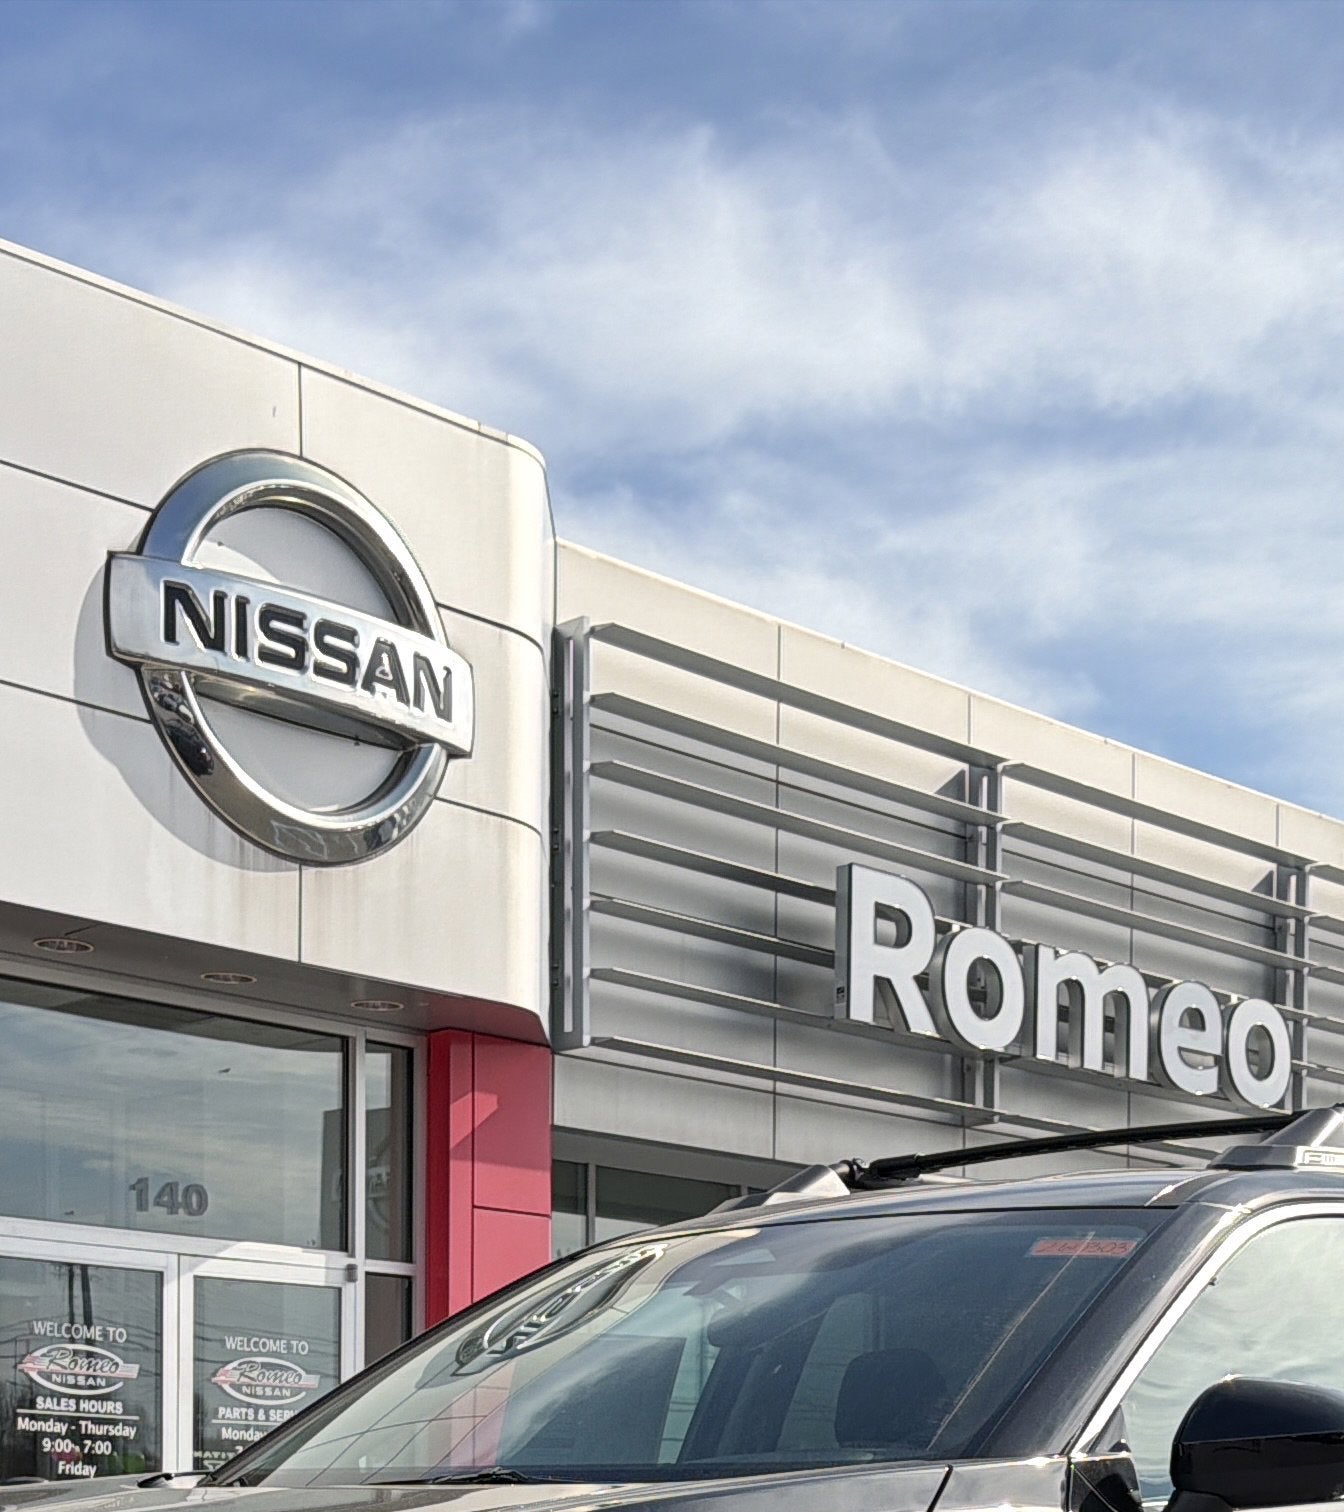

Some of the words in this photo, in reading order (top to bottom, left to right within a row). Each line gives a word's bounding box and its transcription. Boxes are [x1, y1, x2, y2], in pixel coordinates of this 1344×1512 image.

[162, 579, 454, 724] NISSAN
[836, 862, 1292, 1109] Romeo
[129, 1177, 208, 1217] 140
[33, 1320, 103, 1341] WELCOME
[106, 1327, 127, 1344] TO
[225, 1336, 287, 1354] WELCOME
[290, 1340, 309, 1355] TO
[41, 1347, 120, 1374] Romeo
[52, 1374, 106, 1387] NISSAN
[234, 1360, 303, 1385] Romeo
[242, 1385, 291, 1397] NISSAN
[36, 1396, 77, 1412] SALES
[79, 1399, 123, 1415] HOURS
[218, 1406, 255, 1421] PARTS
[258, 1409, 266, 1421] &
[17, 1417, 69, 1436] Monday
[79, 1420, 137, 1440] Thursday
[42, 1438, 72, 1454] 9:00
[84, 1441, 112, 1455] 7:00
[58, 1460, 97, 1479] Friday
